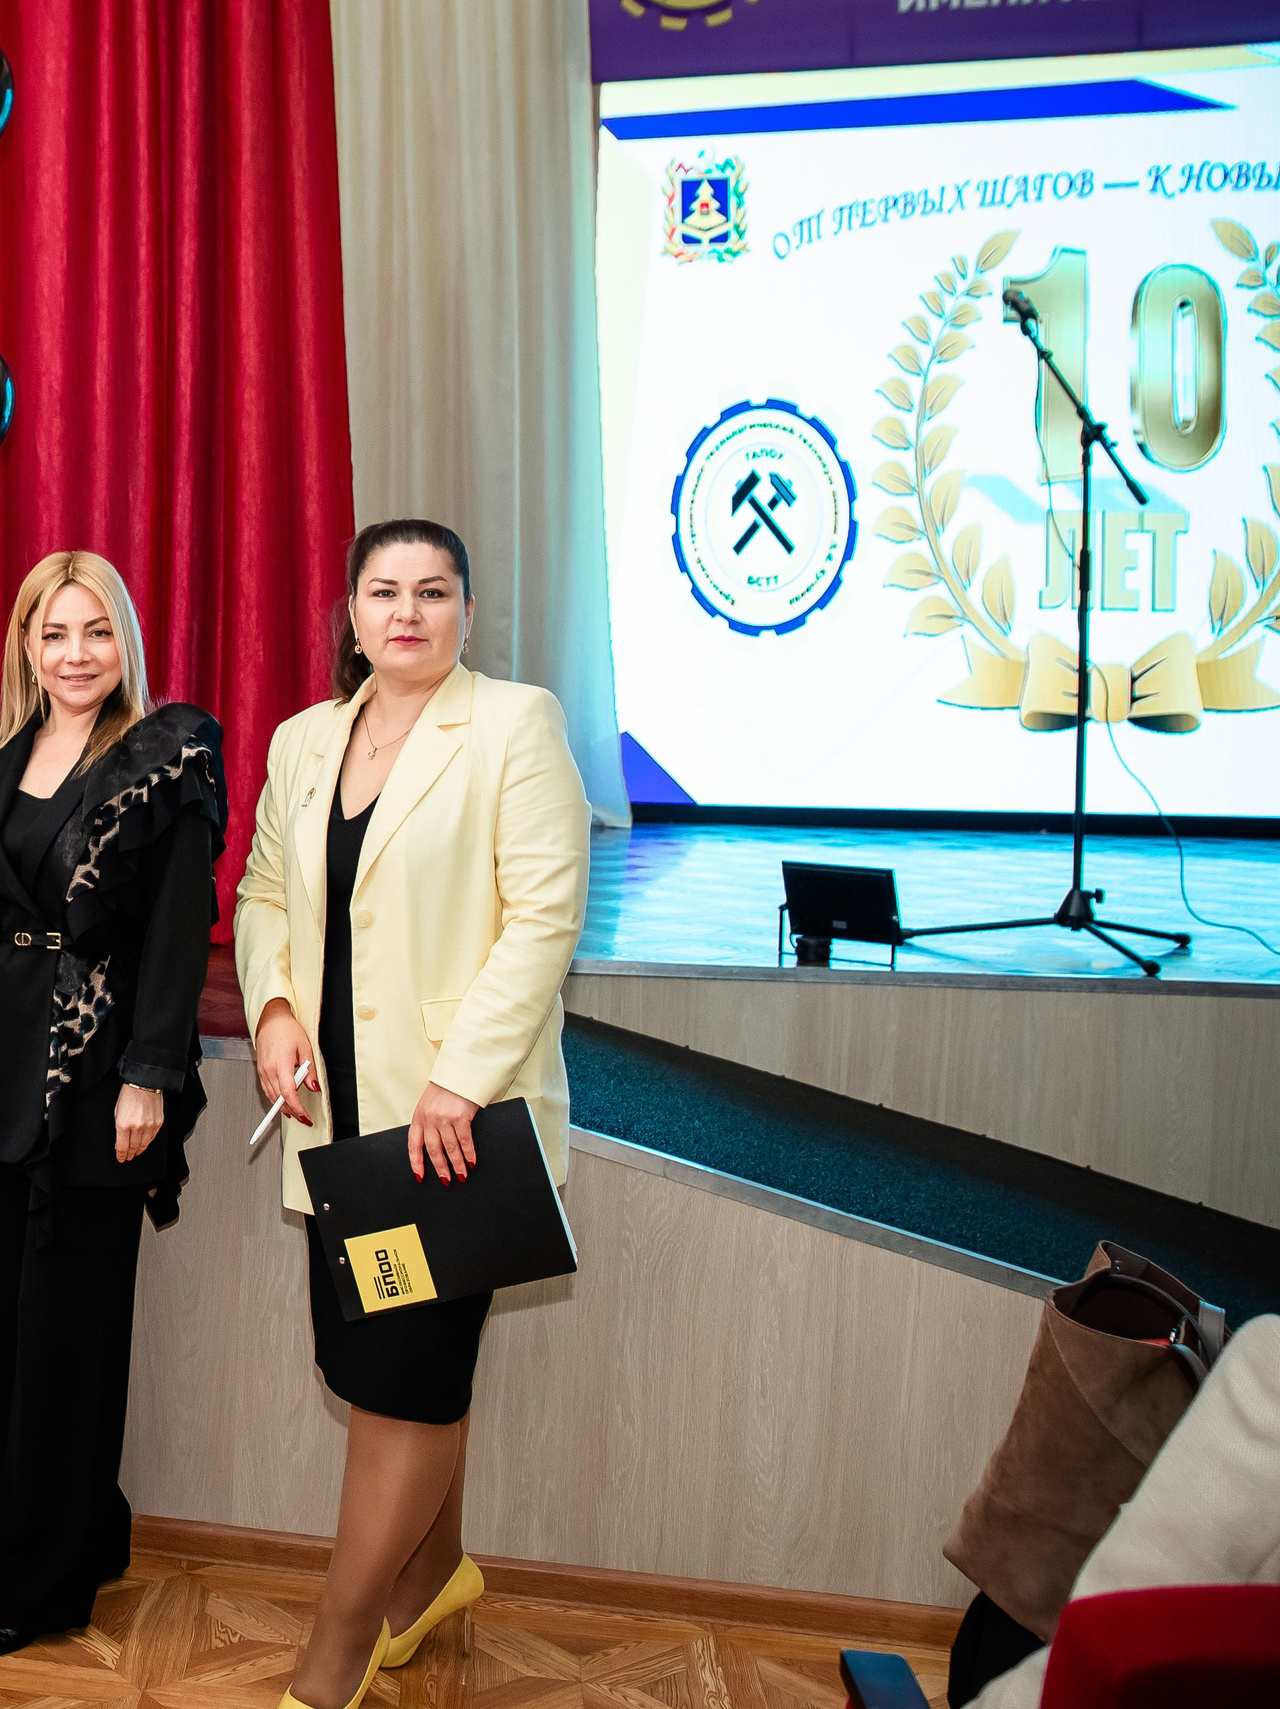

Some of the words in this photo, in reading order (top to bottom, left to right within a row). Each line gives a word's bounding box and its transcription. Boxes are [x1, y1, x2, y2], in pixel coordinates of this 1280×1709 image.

[773, 208, 825, 260] ОТ
[832, 179, 971, 236] ПЕРВЫХ
[976, 168, 1094, 209] ШАГОВ
[1147, 163, 1175, 199] К
[1003, 246, 1228, 485] 10
[1039, 510, 1190, 612] ЛЕТ
[374, 1249, 400, 1298] БПОО
